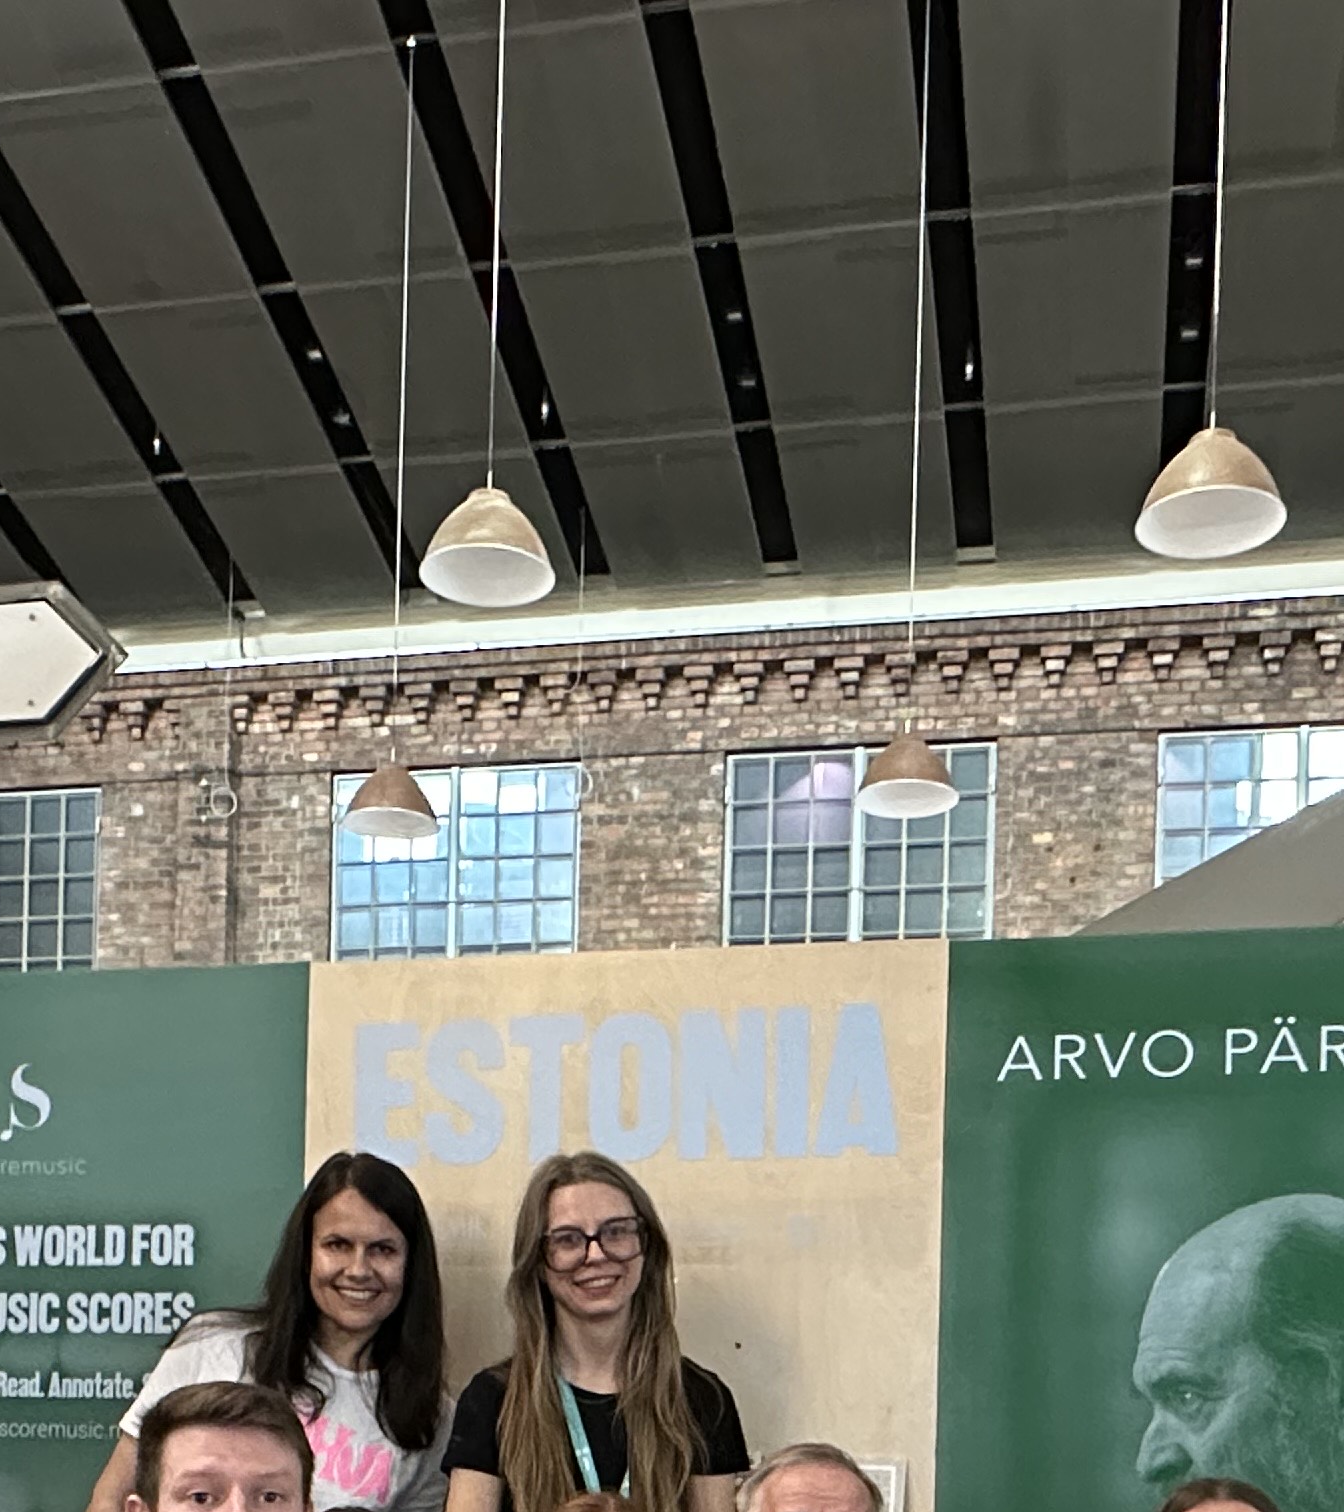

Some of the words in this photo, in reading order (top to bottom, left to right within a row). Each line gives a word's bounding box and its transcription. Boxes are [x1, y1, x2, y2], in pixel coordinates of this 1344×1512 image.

[997, 1029, 1195, 1083] ARVO
[354, 1002, 899, 1167] ESTONIA
[13, 1224, 125, 1268] WORLD
[132, 1223, 194, 1267] FOR
[66, 1292, 195, 1334] SCORES
[48, 1372, 137, 1400] Annotate.
